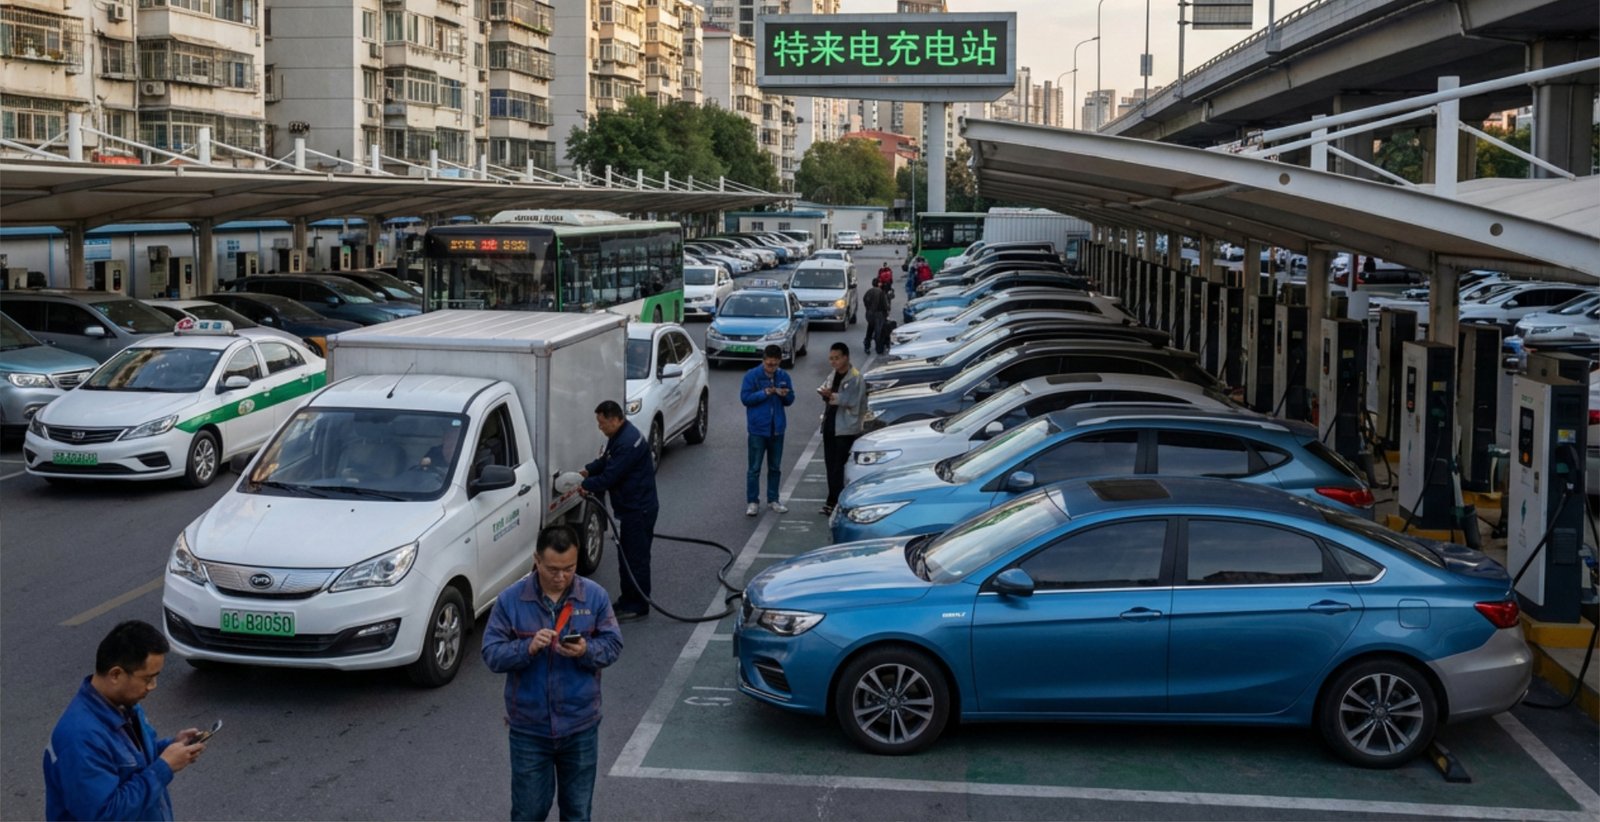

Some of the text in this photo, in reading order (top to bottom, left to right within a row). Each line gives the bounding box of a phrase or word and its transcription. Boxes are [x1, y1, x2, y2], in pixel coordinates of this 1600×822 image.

[773, 29, 997, 68] 特来电充电站
